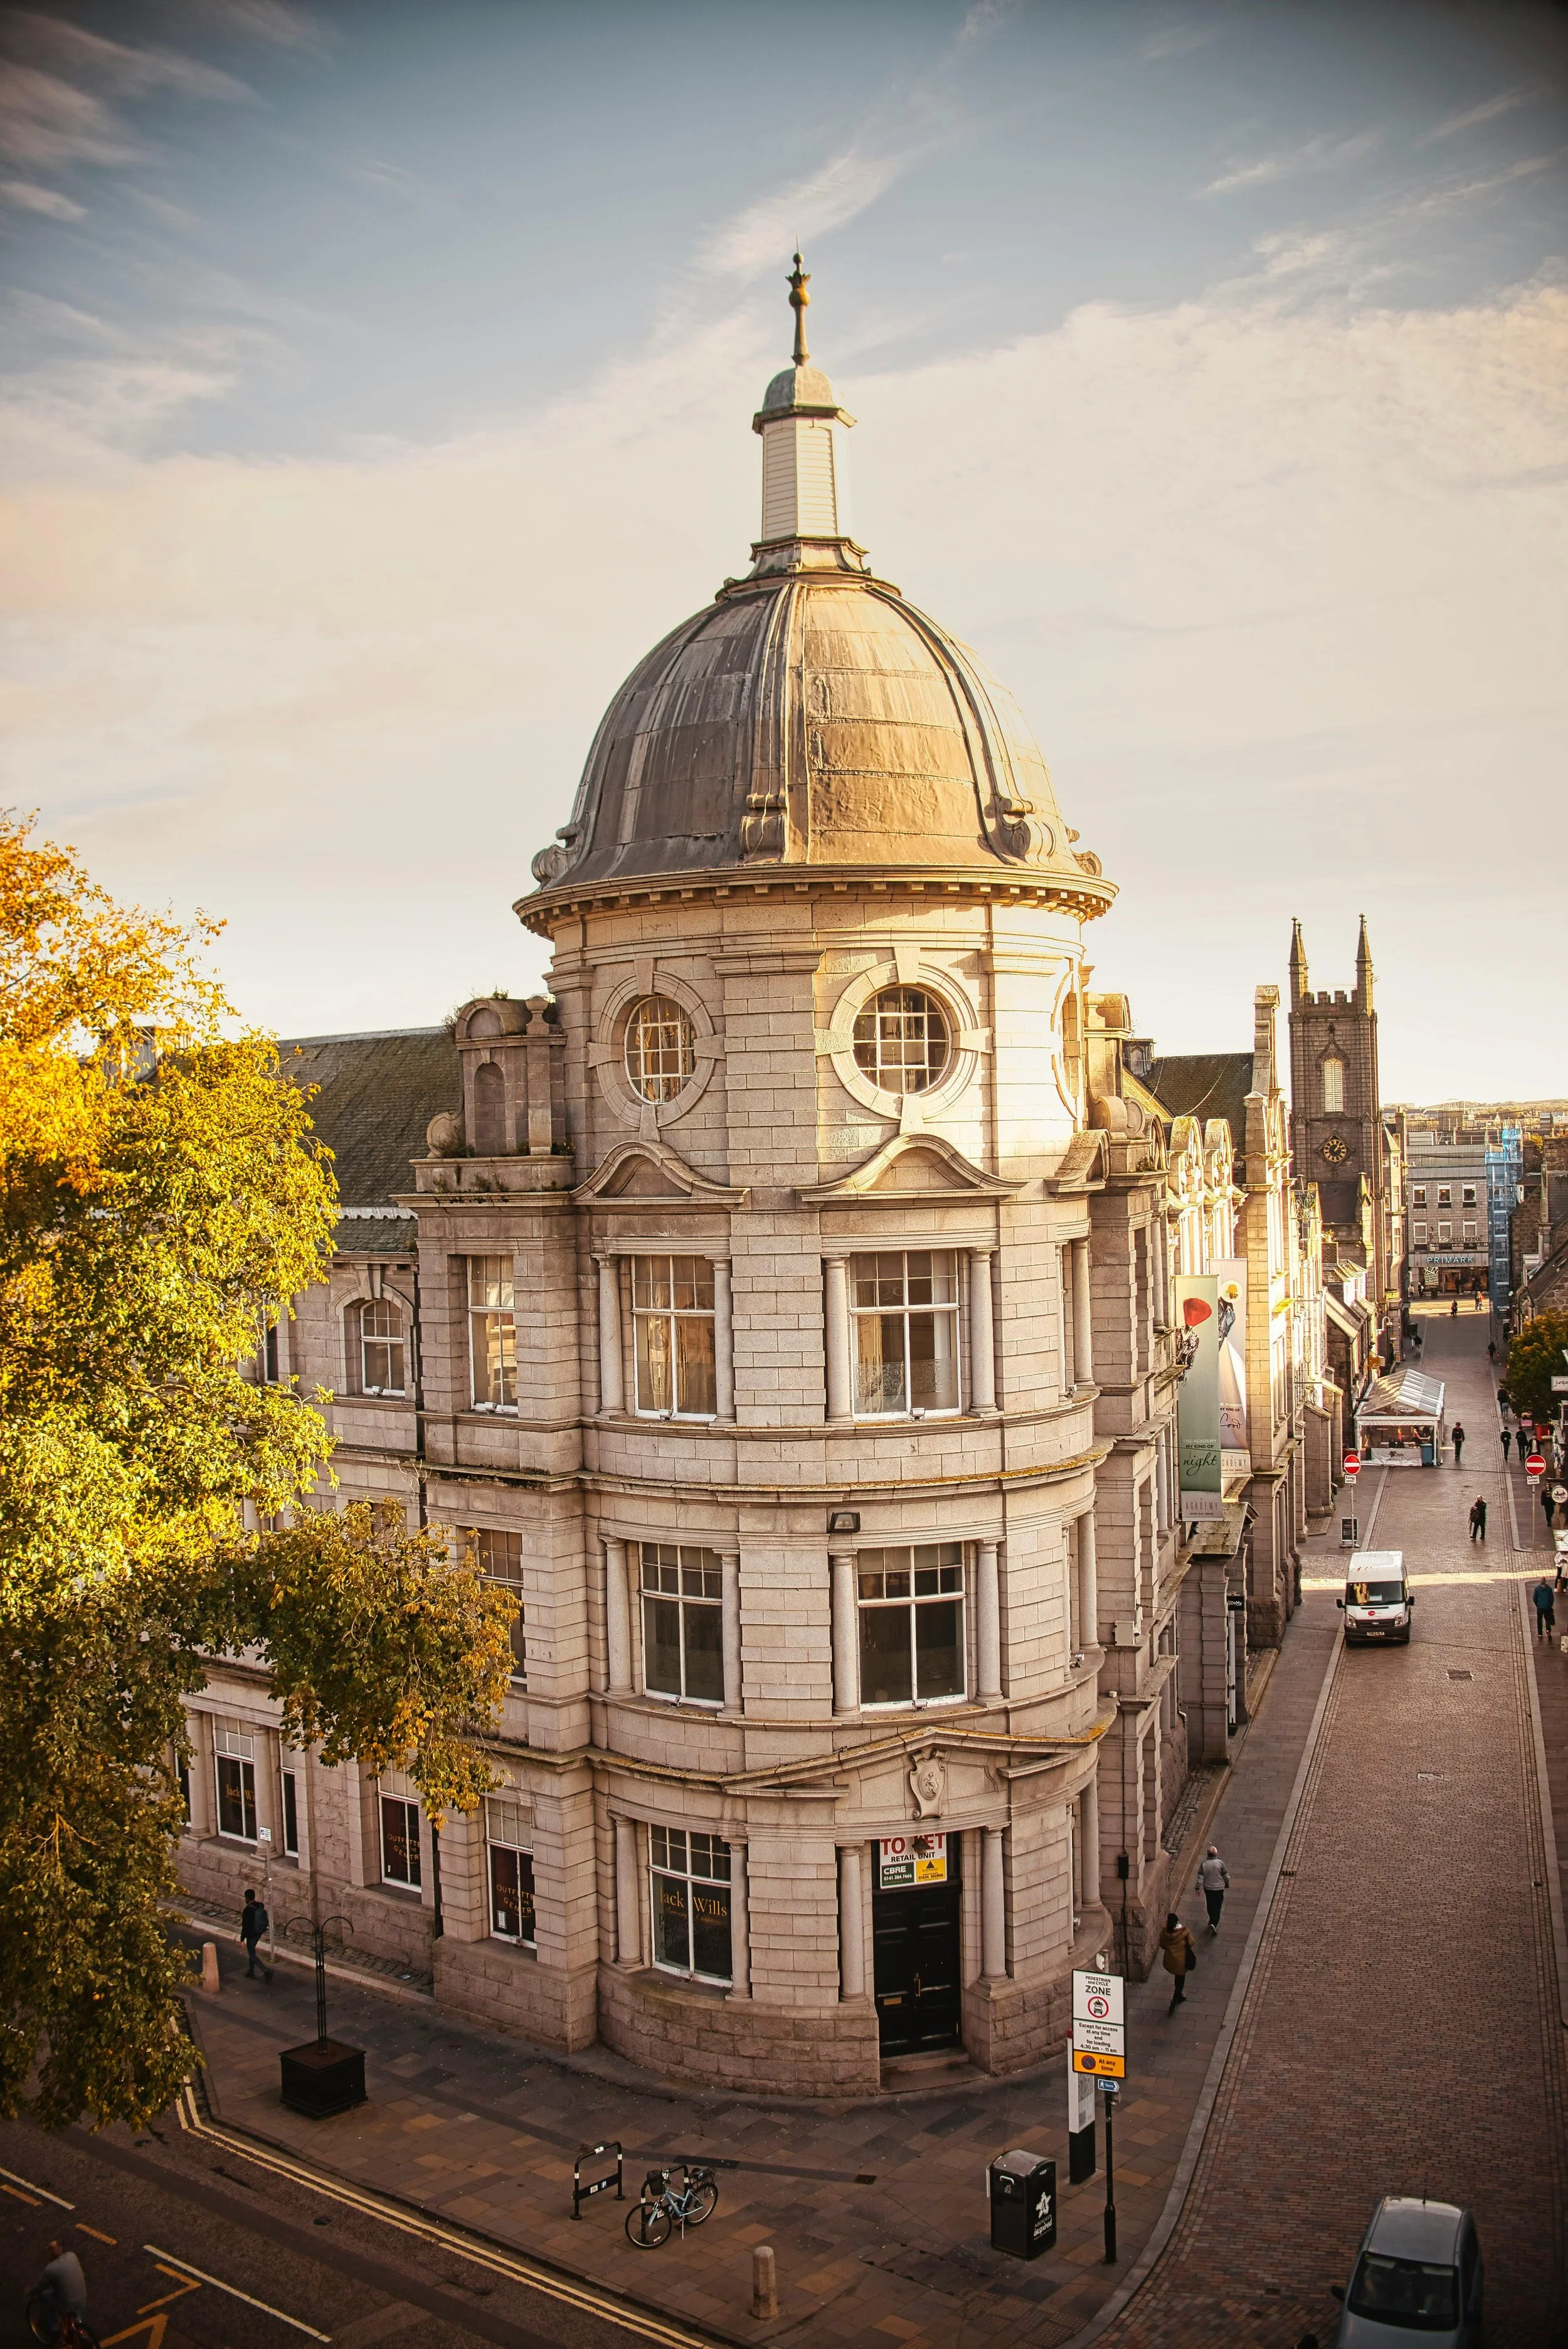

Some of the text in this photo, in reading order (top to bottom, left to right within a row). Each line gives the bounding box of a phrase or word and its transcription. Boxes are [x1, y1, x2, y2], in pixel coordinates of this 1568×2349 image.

[1183, 1452, 1218, 1476] night
[1185, 1502, 1217, 1510] ACADEMY
[226, 1784, 241, 1798] Jack
[394, 1845, 420, 1860] GENTR
[881, 1837, 906, 1855] TO
[891, 1854, 916, 1862] RETAIL
[884, 1865, 906, 1875] CBRE
[496, 1884, 534, 1900] OUTFTTE
[504, 1897, 533, 1914] GENTR
[659, 1887, 727, 1916] Jack Wills
[1085, 1985, 1111, 1996] ZONE
